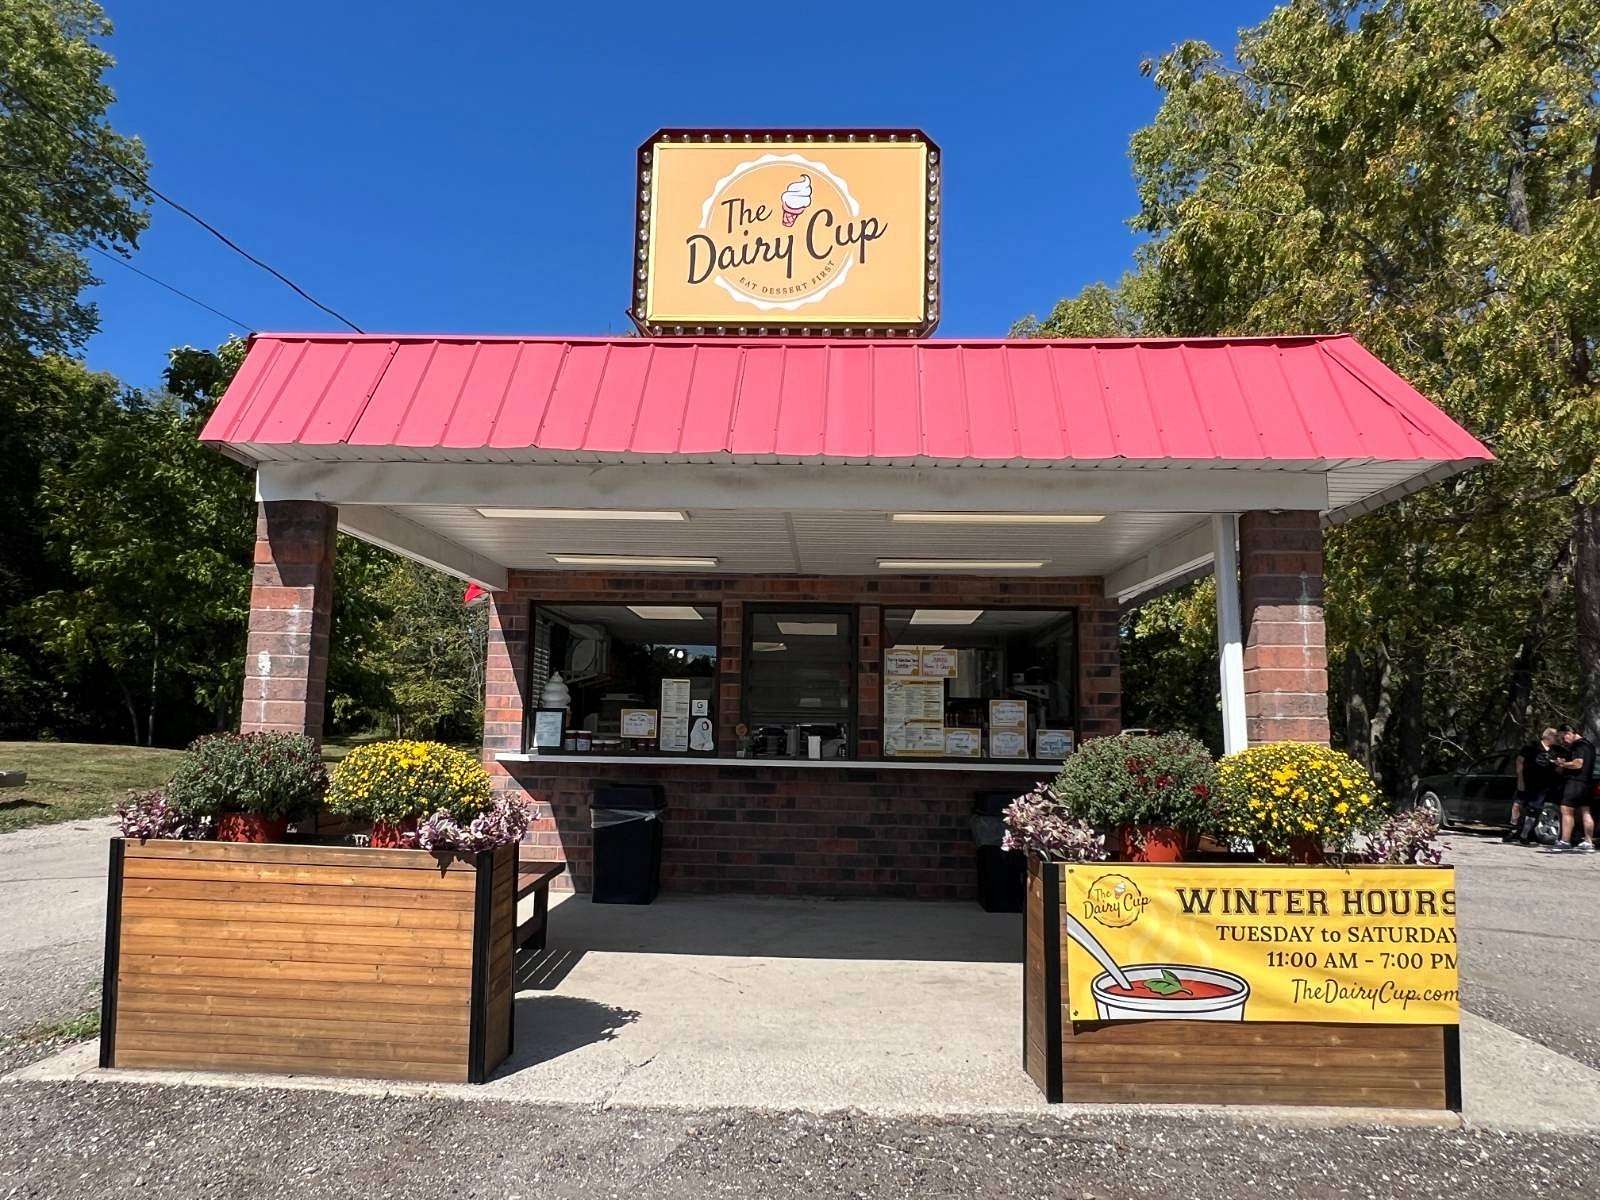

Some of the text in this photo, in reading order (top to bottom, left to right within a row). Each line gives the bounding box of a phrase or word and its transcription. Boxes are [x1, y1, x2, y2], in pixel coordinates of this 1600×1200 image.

[721, 198, 773, 234] The
[686, 208, 889, 285] Dairy Cup
[738, 260, 836, 295] EAT DESSERT FIRST
[1083, 899, 1120, 919] Dairy
[1124, 893, 1151, 913] Cup
[1094, 888, 1112, 902] The
[1175, 887, 1456, 918] WINTER HOURS
[1216, 925, 1317, 944] TUESDAY
[1321, 927, 1341, 944] to
[1266, 952, 1318, 969] 11:00
[1324, 953, 1358, 970] AM
[1379, 952, 1423, 970] 7:00
[1291, 978, 1460, 1011] TheDairyCup.com
